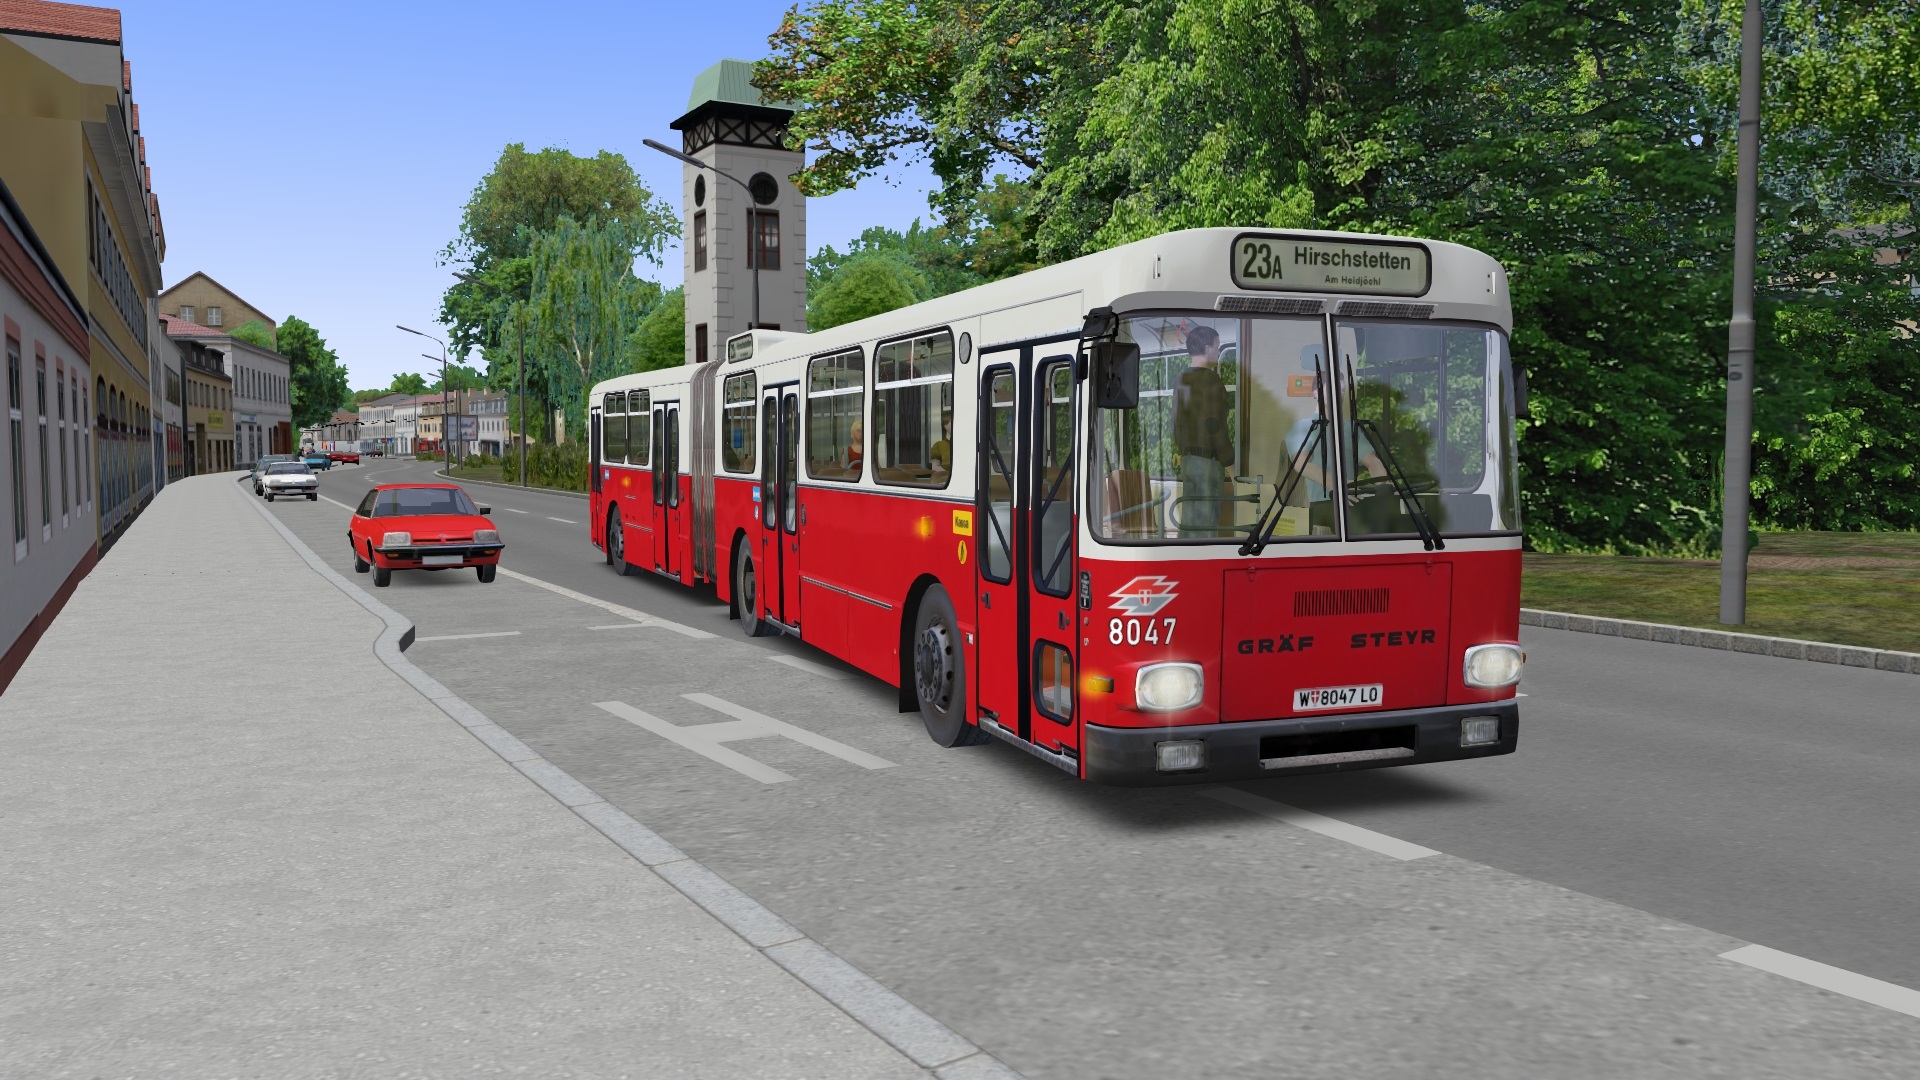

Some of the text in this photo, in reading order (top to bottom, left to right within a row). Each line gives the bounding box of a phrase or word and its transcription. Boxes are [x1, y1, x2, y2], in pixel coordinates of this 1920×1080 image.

[1242, 242, 1411, 280] 23A Hirschstetten
[1325, 275, 1338, 284] Am
[1108, 618, 1177, 646] 8047
[1238, 629, 1436, 655] GRÄF STEYR
[1320, 688, 1356, 705] 8047
